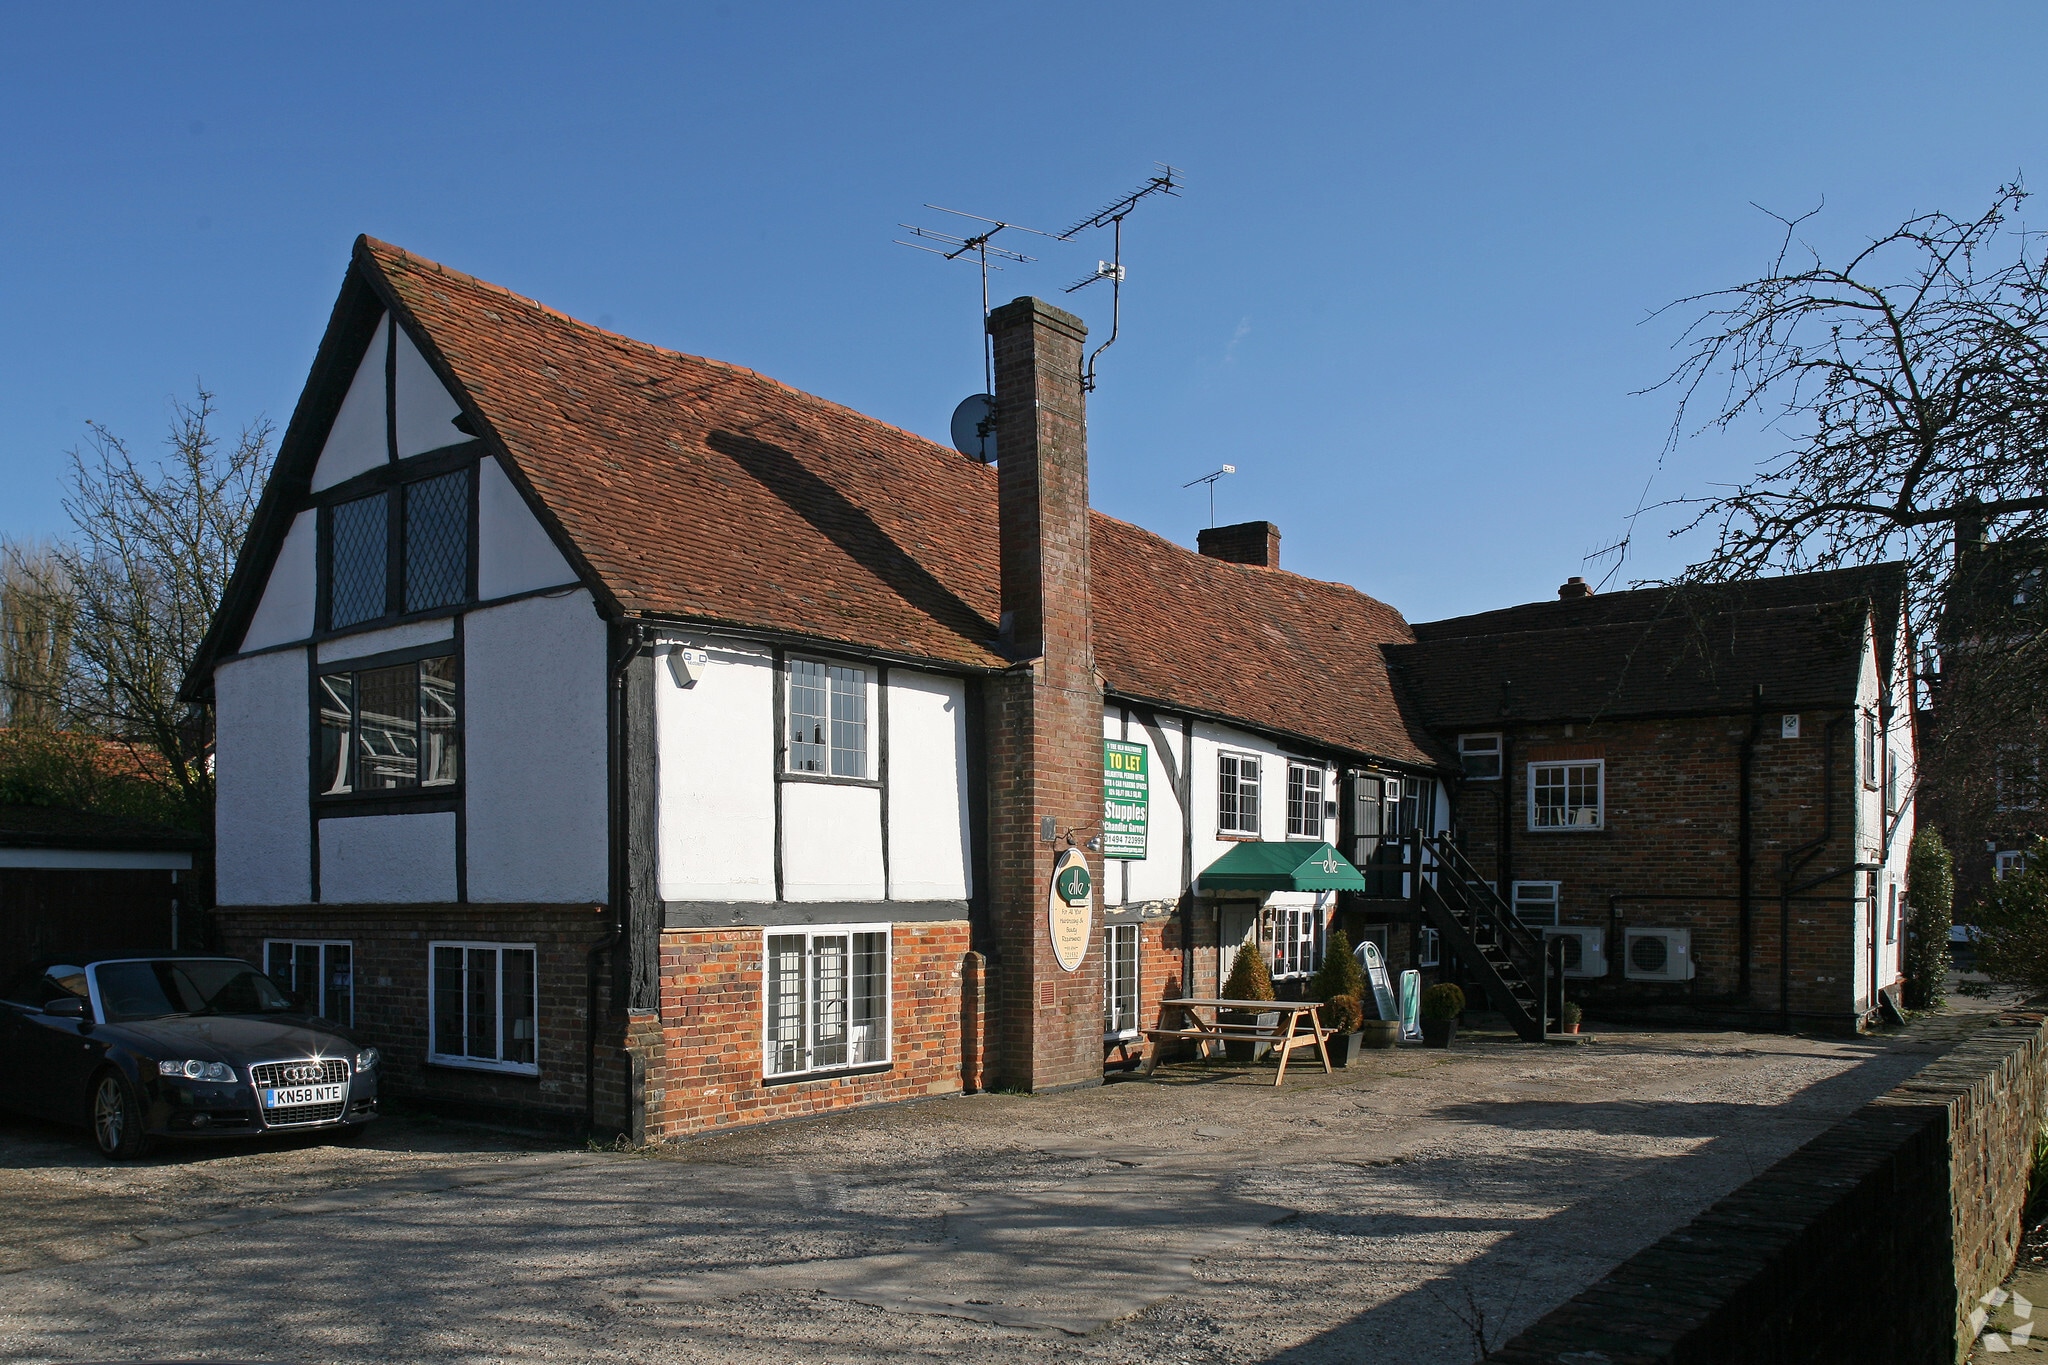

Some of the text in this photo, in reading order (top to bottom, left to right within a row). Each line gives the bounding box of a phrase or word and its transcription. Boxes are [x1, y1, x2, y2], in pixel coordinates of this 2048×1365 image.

[1110, 752, 1140, 772] TO LET
[1105, 800, 1145, 822] Stupples
[1104, 821, 1144, 834] Chandler Garvey
[1125, 836, 1144, 844] 723999
[1068, 870, 1084, 895] elle
[277, 1086, 340, 1104] KN58 NTE
